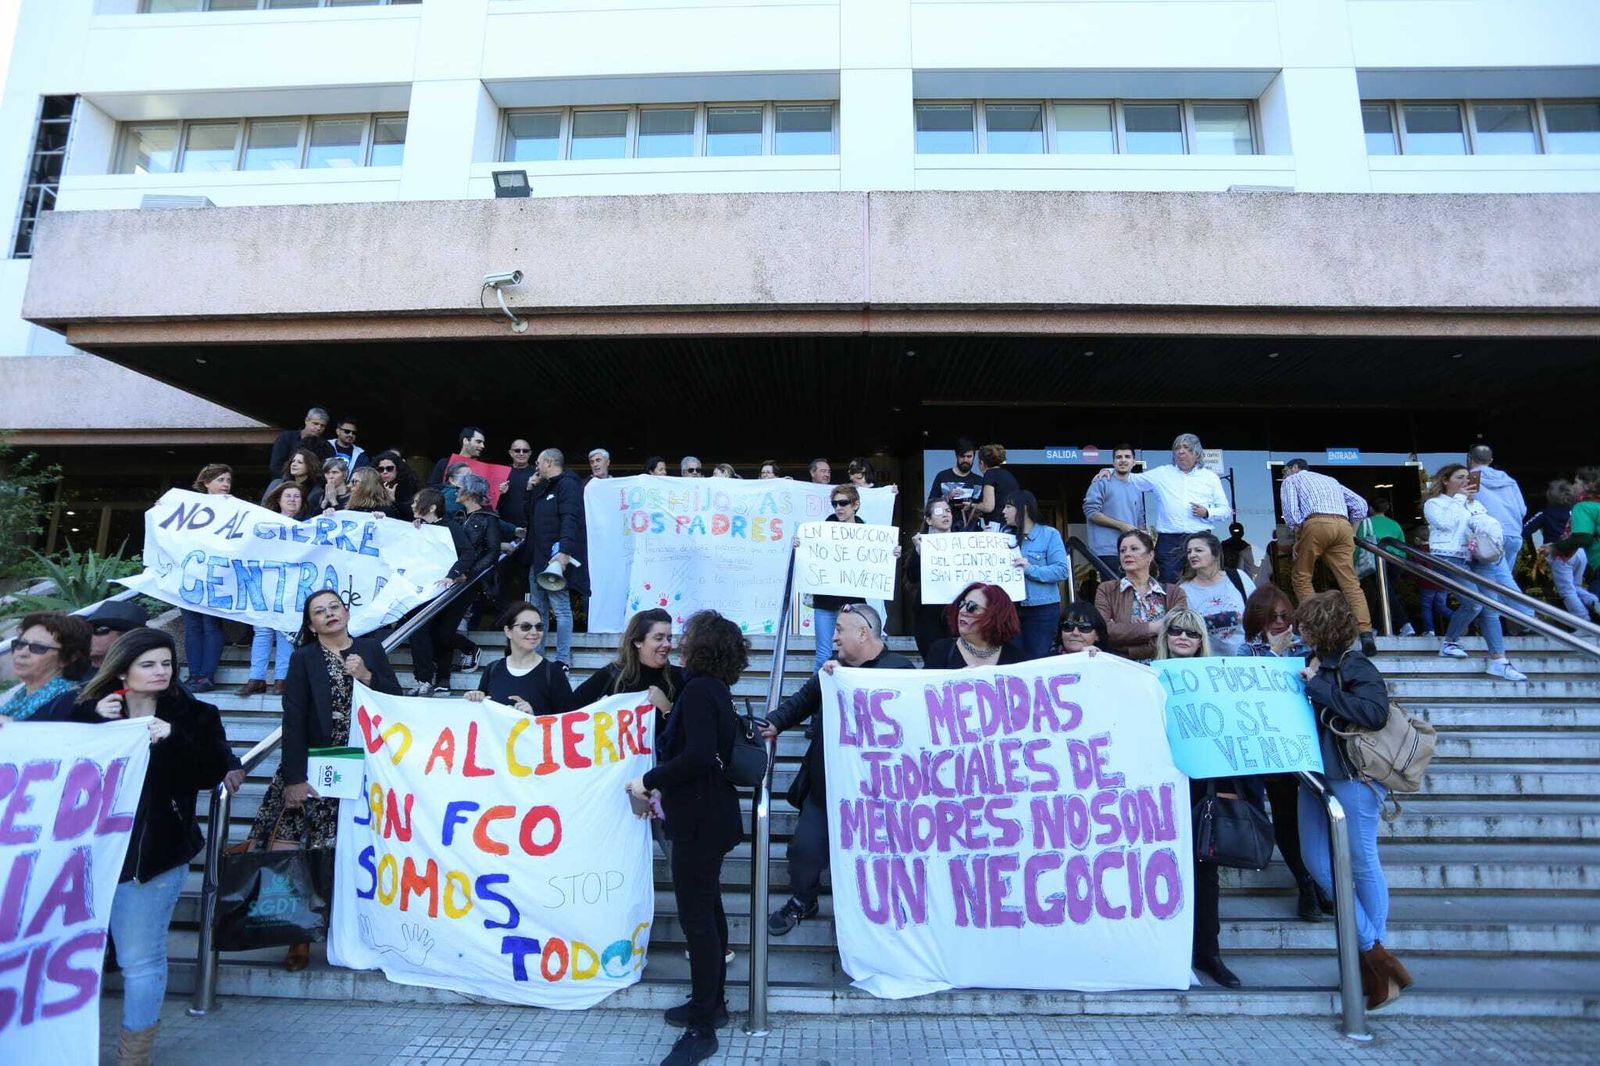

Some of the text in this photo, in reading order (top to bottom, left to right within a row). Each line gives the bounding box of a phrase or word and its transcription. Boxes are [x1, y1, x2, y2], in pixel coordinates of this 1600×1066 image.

[1046, 450, 1078, 459] SALIDA
[1327, 451, 1358, 460] ENTRADA
[619, 486, 662, 510] LOS
[158, 502, 215, 531] NO
[213, 510, 250, 540] AL
[623, 511, 665, 537] LOS
[675, 513, 784, 543] PADRES
[804, 525, 822, 539] EN
[831, 526, 896, 544] EDUCACION
[809, 543, 889, 564] NO SE GASTA
[927, 535, 1010, 551] NO AL CIERRE
[930, 556, 950, 567] DEL
[953, 552, 998, 567] CENTRO
[341, 574, 363, 609] de
[805, 563, 830, 586] SE
[840, 569, 893, 592] INVIERTE
[931, 568, 951, 582] SAN
[956, 569, 974, 582] FCO
[978, 569, 992, 583] DE
[1164, 668, 1200, 696] LO
[837, 673, 1084, 748] LAS MEDIDAS
[1172, 700, 1280, 740] NO SE
[424, 720, 495, 777] AL
[505, 703, 654, 778] CIERRE
[1214, 734, 1321, 772] VENDE
[324, 765, 333, 787] SGDT
[860, 731, 1126, 801] JUDICIALES DE
[353, 774, 563, 857] SAN FCO
[839, 795, 1025, 854] MENORES
[356, 845, 521, 930] SOMOS
[543, 870, 625, 910] STOP
[855, 845, 1185, 930] UN NEGOCIO
[247, 897, 301, 918] SGDT
[501, 921, 651, 983] TODOS
